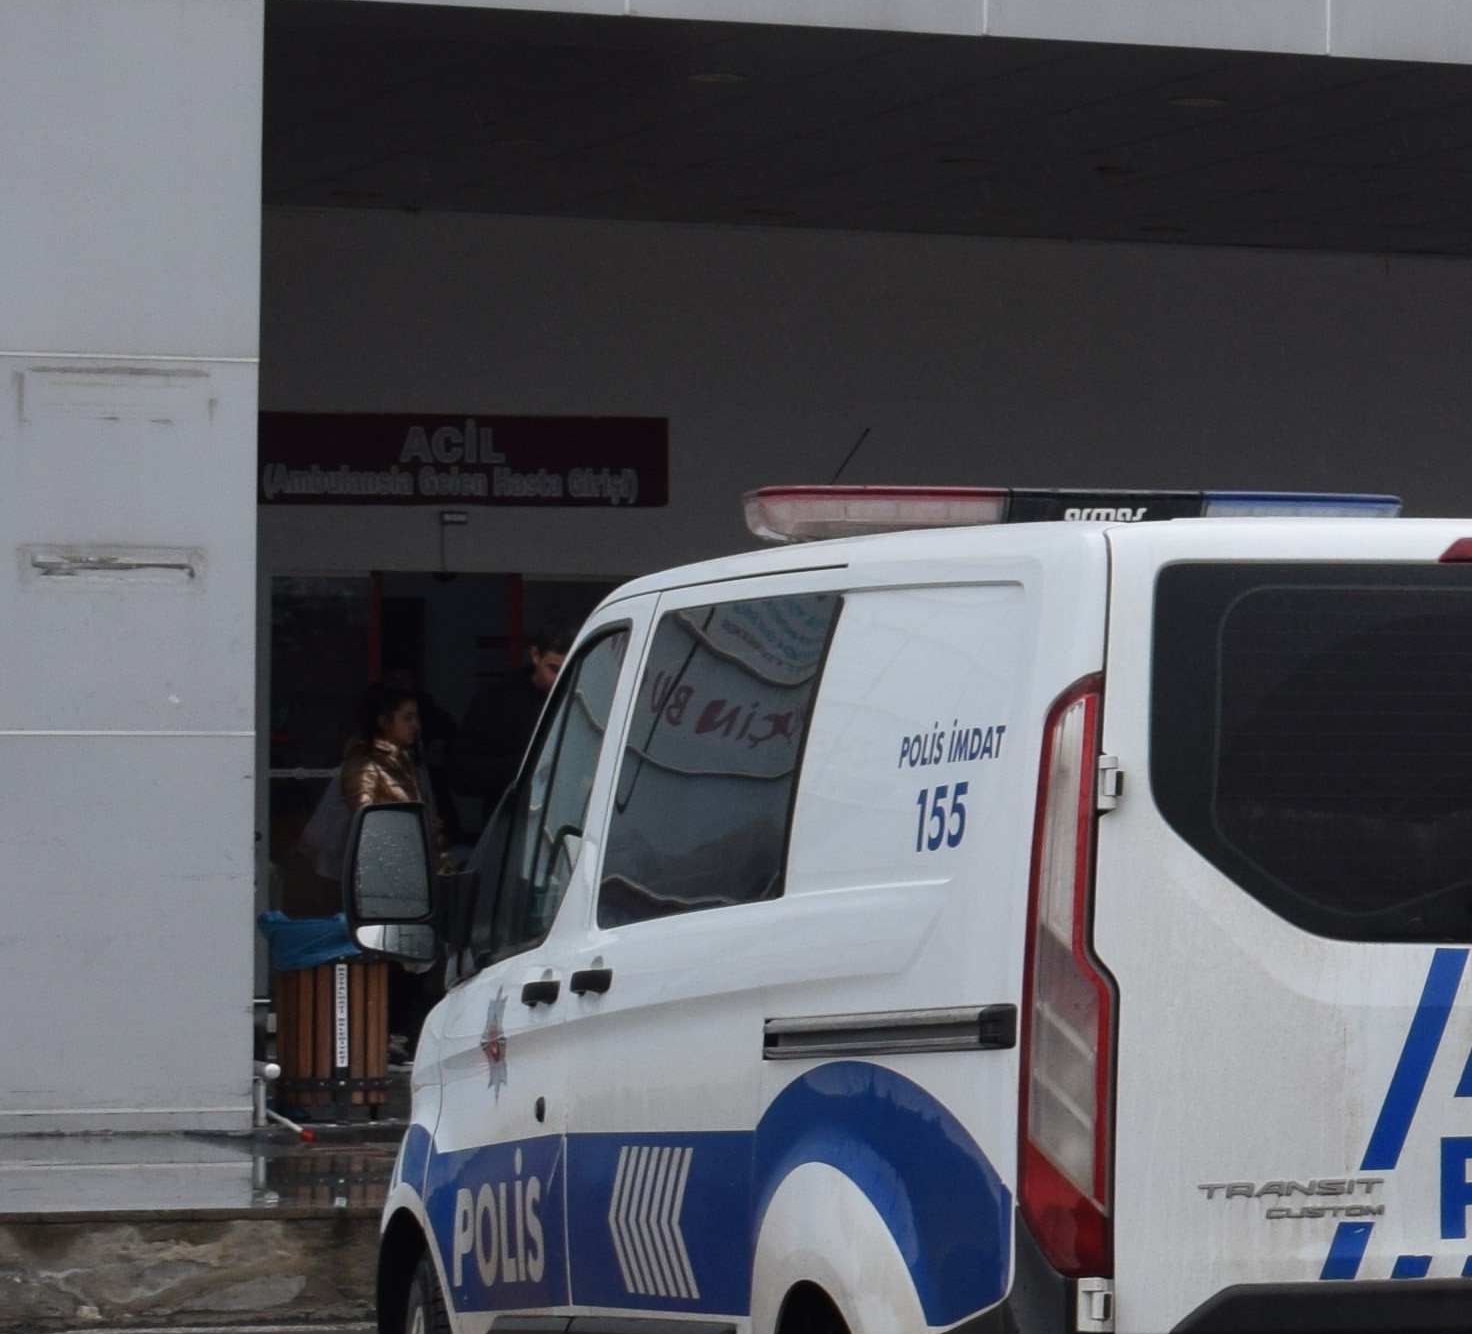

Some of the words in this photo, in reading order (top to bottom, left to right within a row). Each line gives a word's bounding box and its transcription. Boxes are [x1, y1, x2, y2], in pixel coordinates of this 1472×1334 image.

[400, 419, 506, 464] ACİL
[898, 720, 946, 769] POLİS
[947, 718, 1007, 763] İMDAT
[915, 780, 970, 853] 155
[1197, 1177, 1385, 1200] TRANSIT
[1265, 1204, 1385, 1220] CUSTOM
[452, 1147, 545, 1288] POLİS
